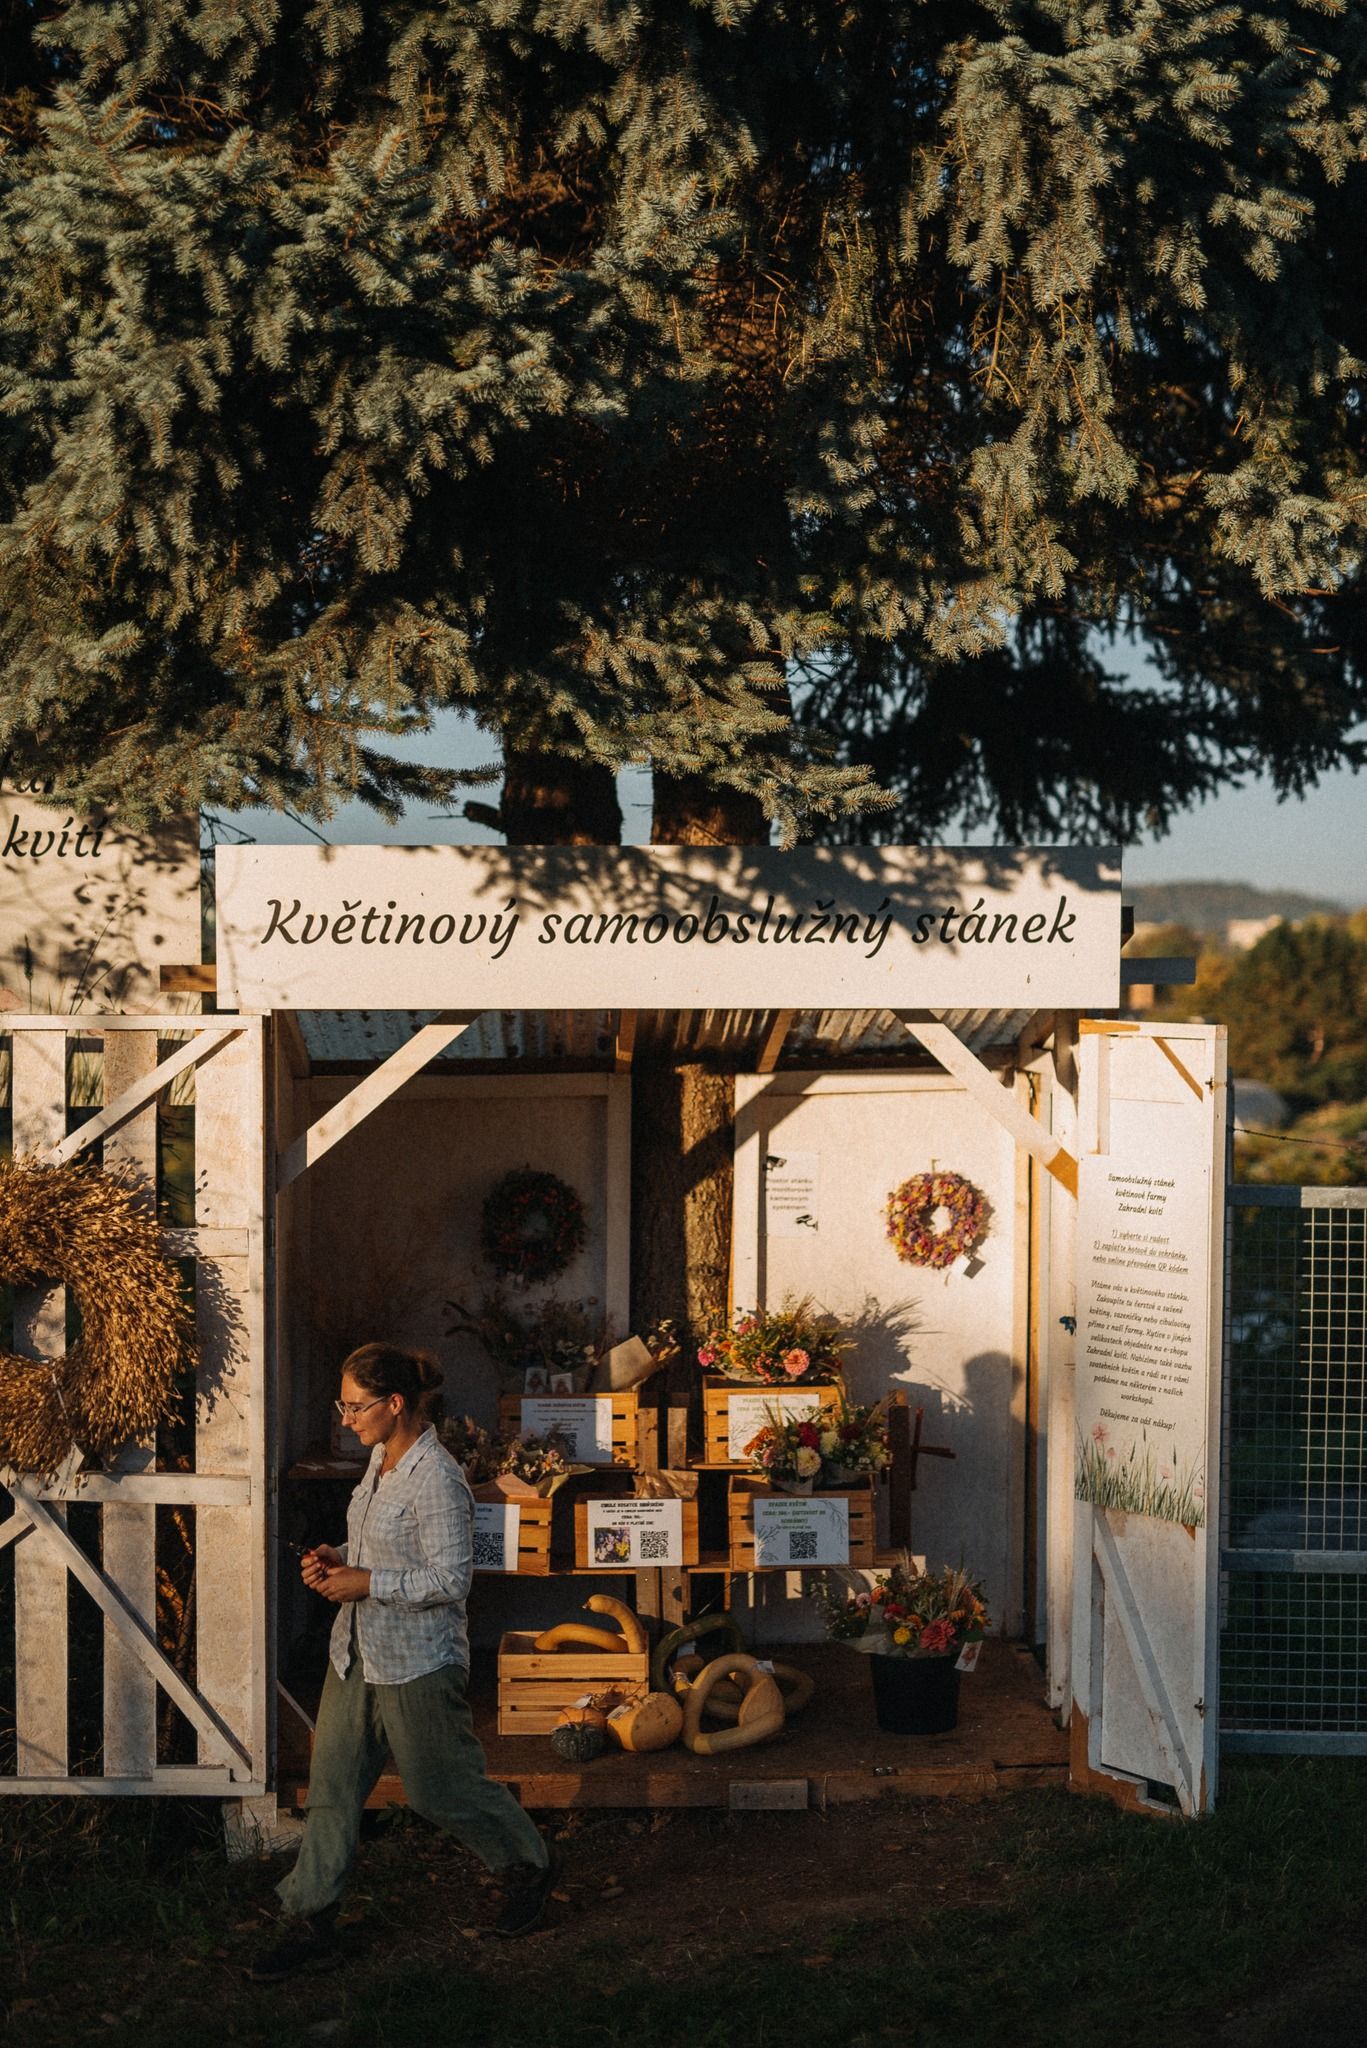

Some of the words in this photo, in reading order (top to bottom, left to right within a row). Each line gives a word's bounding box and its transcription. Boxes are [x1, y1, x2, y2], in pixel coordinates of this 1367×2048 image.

[2, 814, 108, 857] kvítí
[261, 898, 519, 960] Květinový
[538, 895, 894, 959] samoobslužný
[911, 896, 1076, 943] stánek
[1108, 1173, 1152, 1187] Samoobslužný
[1154, 1178, 1175, 1188] stánek
[1115, 1188, 1145, 1199] květinové
[1147, 1191, 1166, 1203] farmy
[1118, 1203, 1147, 1214] Zahradní
[1092, 1254, 1106, 1263] nebo
[1126, 1259, 1156, 1270] převodem
[1091, 1280, 1111, 1289] Vítáme
[1130, 1285, 1165, 1298] květinového
[1144, 1314, 1158, 1323] nebo
[1088, 1320, 1105, 1329] přímo
[1124, 1325, 1145, 1337] farmy.
[1146, 1328, 1165, 1339] Kytice
[1091, 1334, 1122, 1345] velikostech
[1164, 1346, 1188, 1357] e-shopu
[1087, 1345, 1112, 1357] Zahradní
[1160, 1359, 1172, 1367] také
[1122, 1364, 1139, 1376] květin
[1093, 1375, 1119, 1385] potkáme
[1130, 1381, 1156, 1392] některém
[1163, 1388, 1183, 1397] našich
[1100, 1408, 1129, 1421] Děkujeme
[1140, 1416, 1151, 1425] váš
[1153, 1419, 1176, 1431] nákup!
